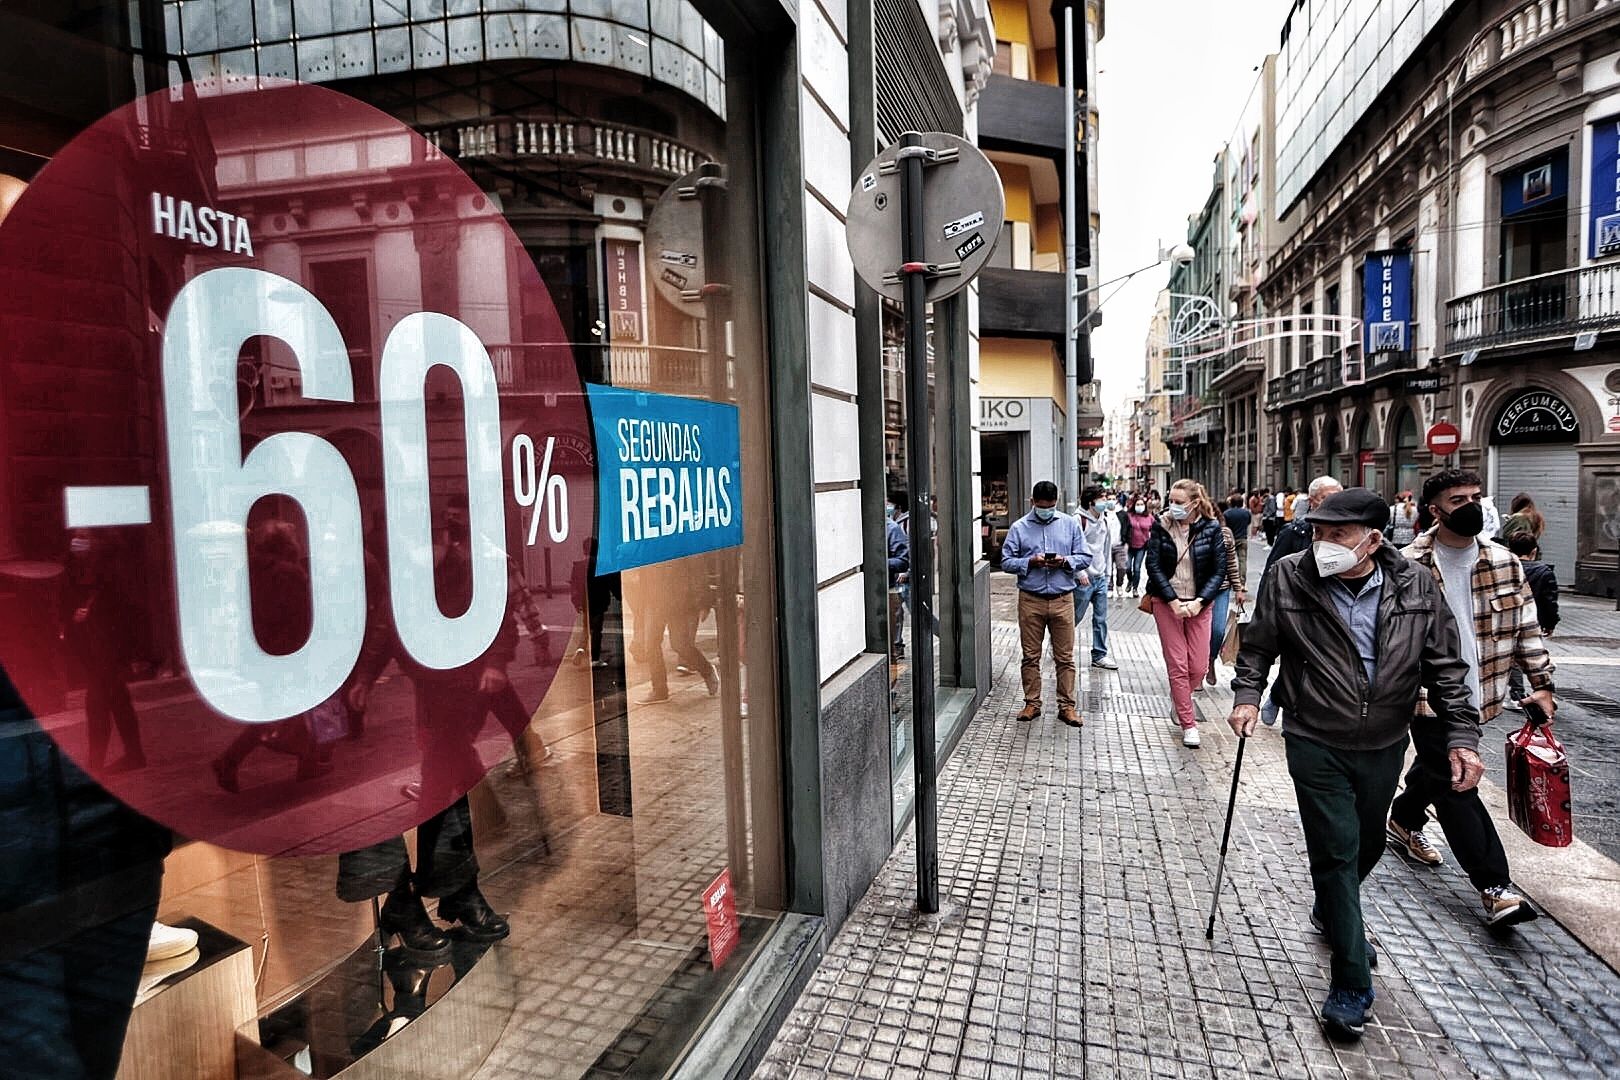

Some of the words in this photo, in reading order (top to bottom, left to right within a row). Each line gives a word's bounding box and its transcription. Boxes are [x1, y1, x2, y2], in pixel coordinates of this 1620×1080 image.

[151, 192, 255, 258] HASTA
[1381, 255, 1394, 322] WEHBE
[1503, 396, 1572, 428] PERFUMERY
[1514, 424, 1557, 434] COSMETICS
[617, 418, 701, 463] SEGUNDAS
[619, 466, 732, 543] REBAJAS
